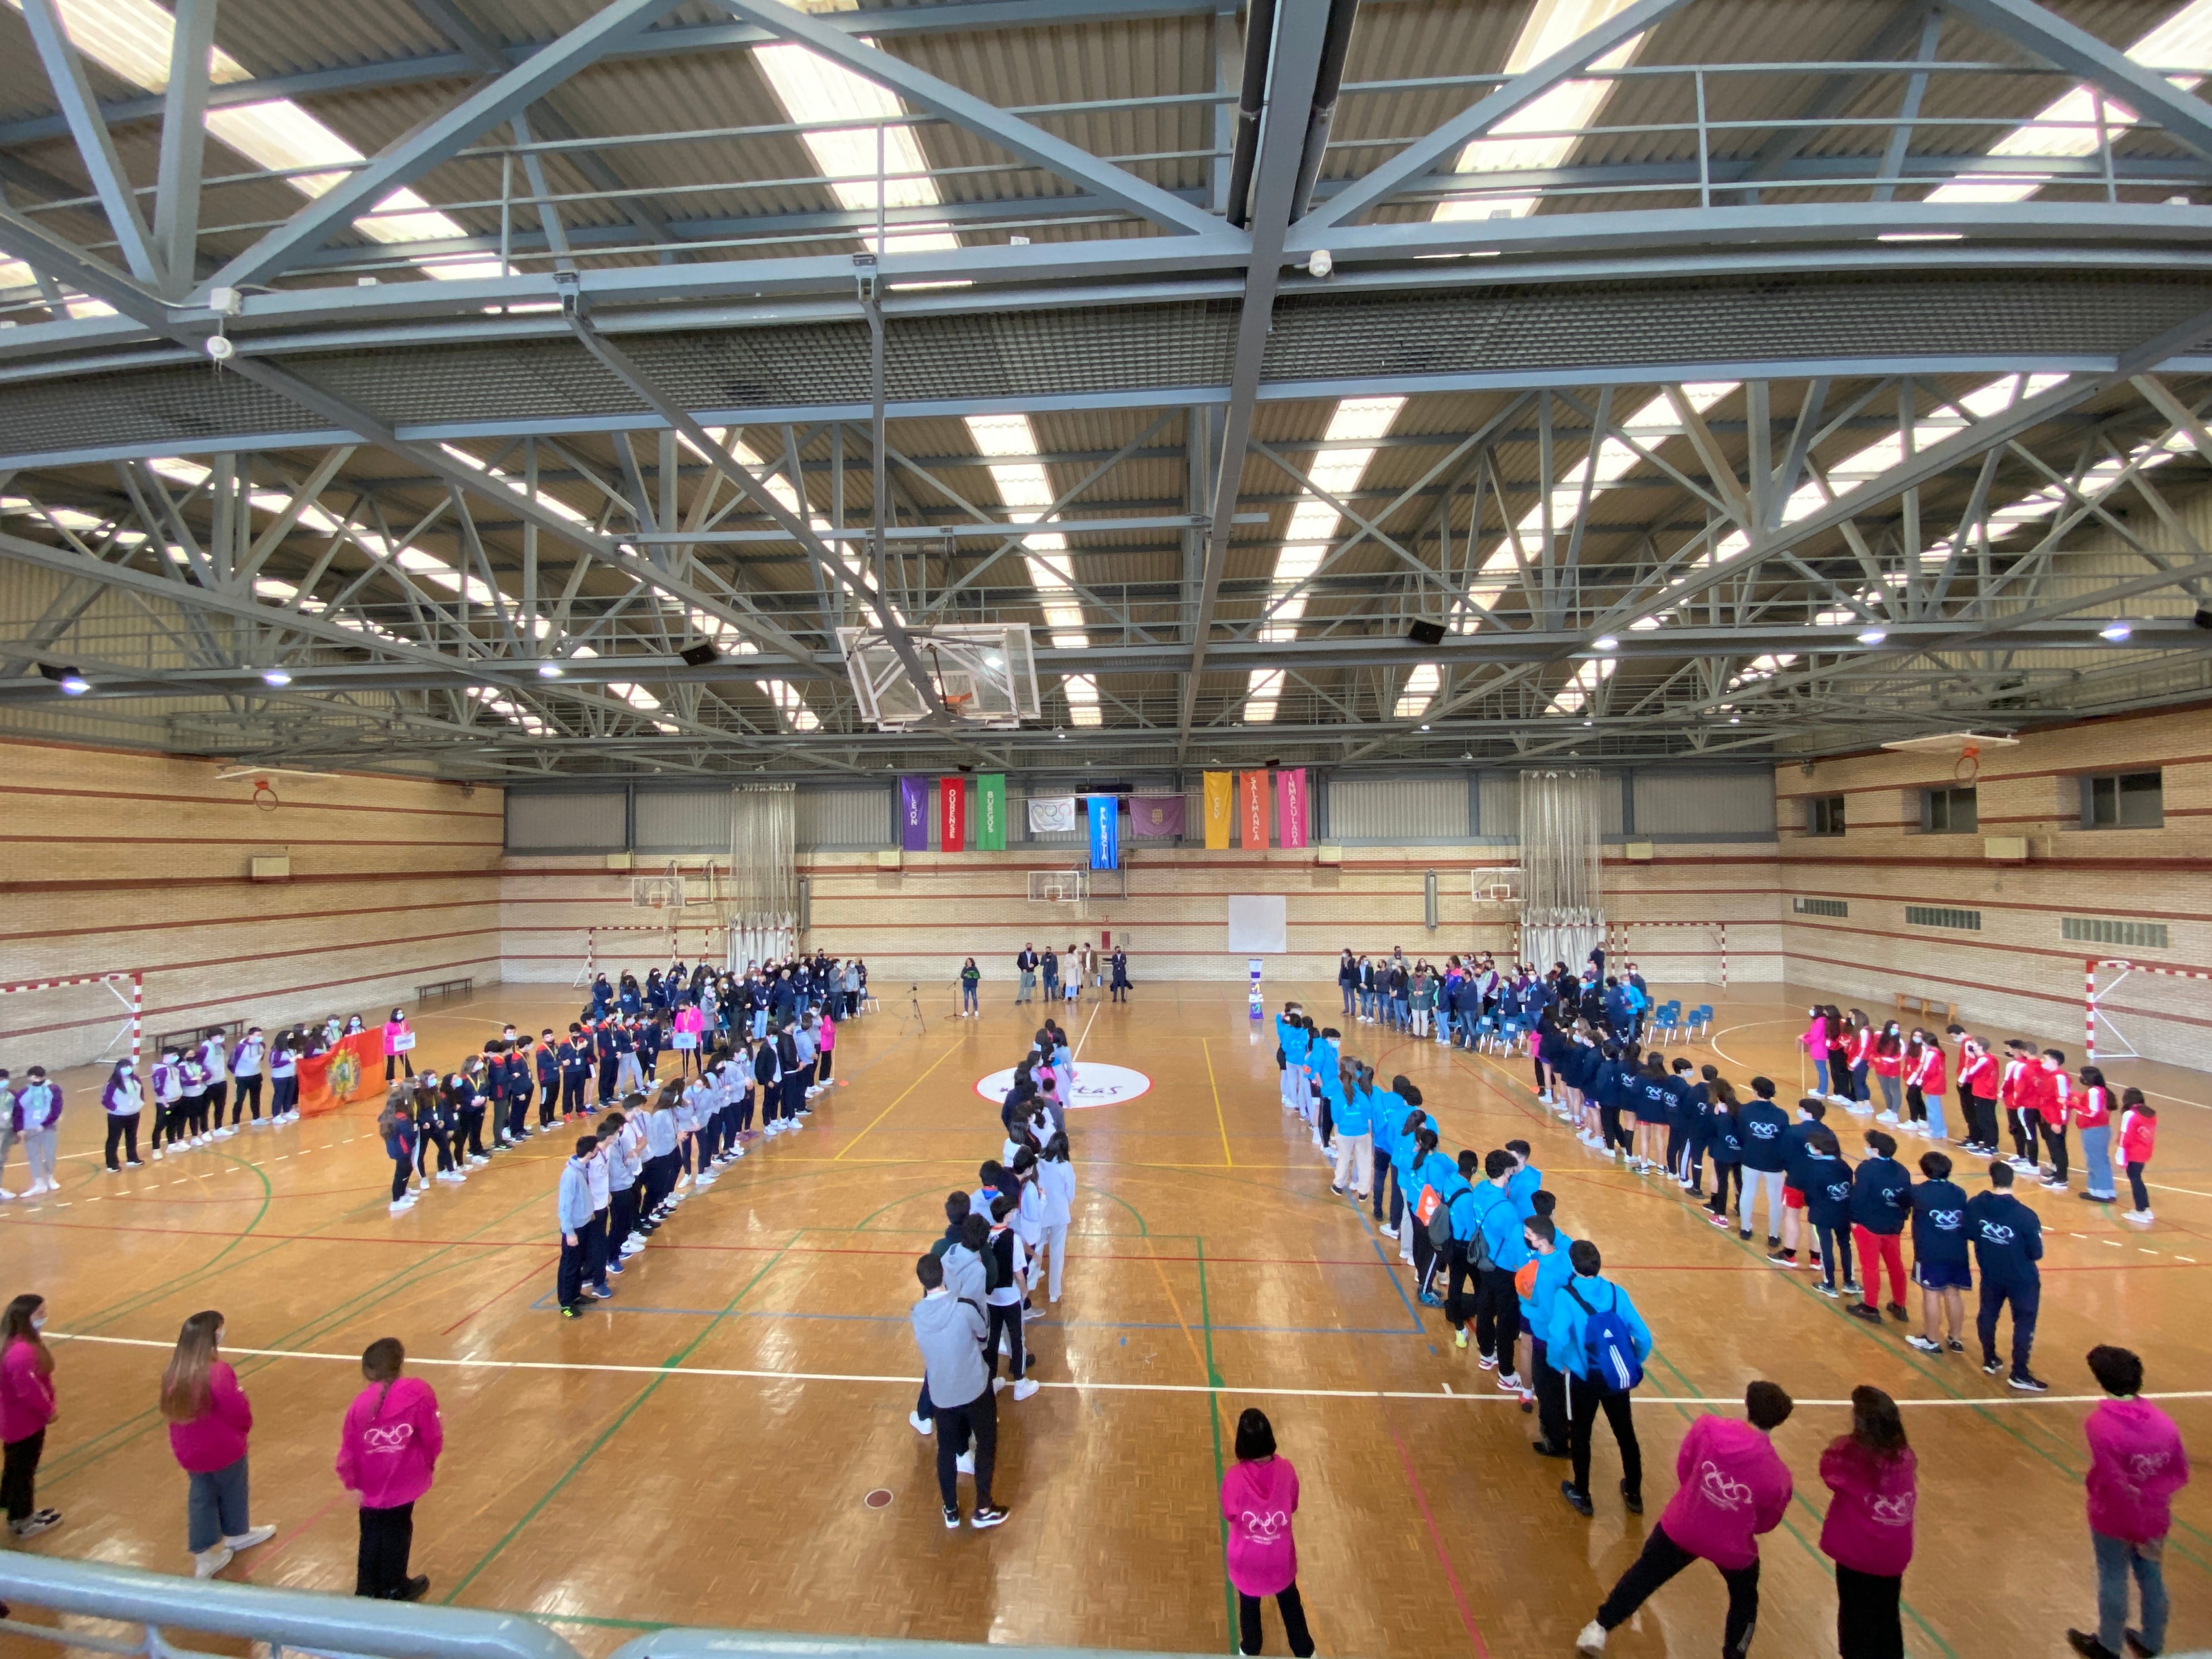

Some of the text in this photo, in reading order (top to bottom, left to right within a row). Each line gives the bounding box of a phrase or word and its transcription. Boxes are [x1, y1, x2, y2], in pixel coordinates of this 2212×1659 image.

[1099, 806, 1108, 861] PALENCIA
[1250, 776, 1260, 842] SALAMANCA
[1288, 774, 1299, 845] INMACULADA
